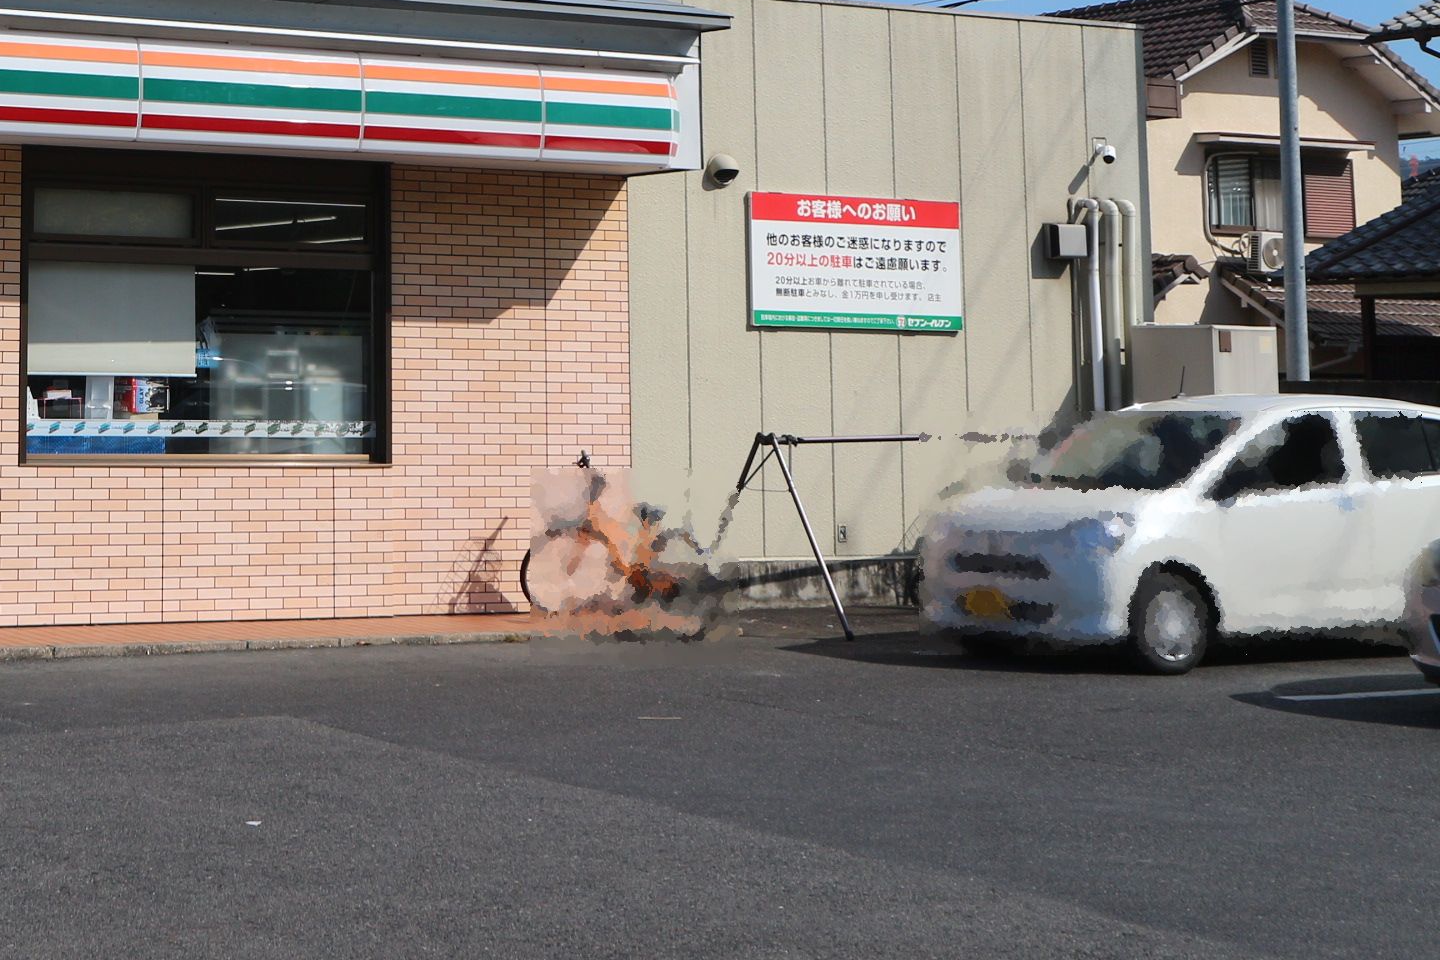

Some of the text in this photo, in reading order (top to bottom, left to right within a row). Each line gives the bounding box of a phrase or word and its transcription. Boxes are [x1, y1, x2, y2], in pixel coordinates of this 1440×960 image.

[796, 199, 916, 222] お客様へのお願い
[766, 233, 948, 254] 他のお客様のご迷惑になりますので
[767, 252, 948, 273] 20分以上の駐車はご遠慮願います。
